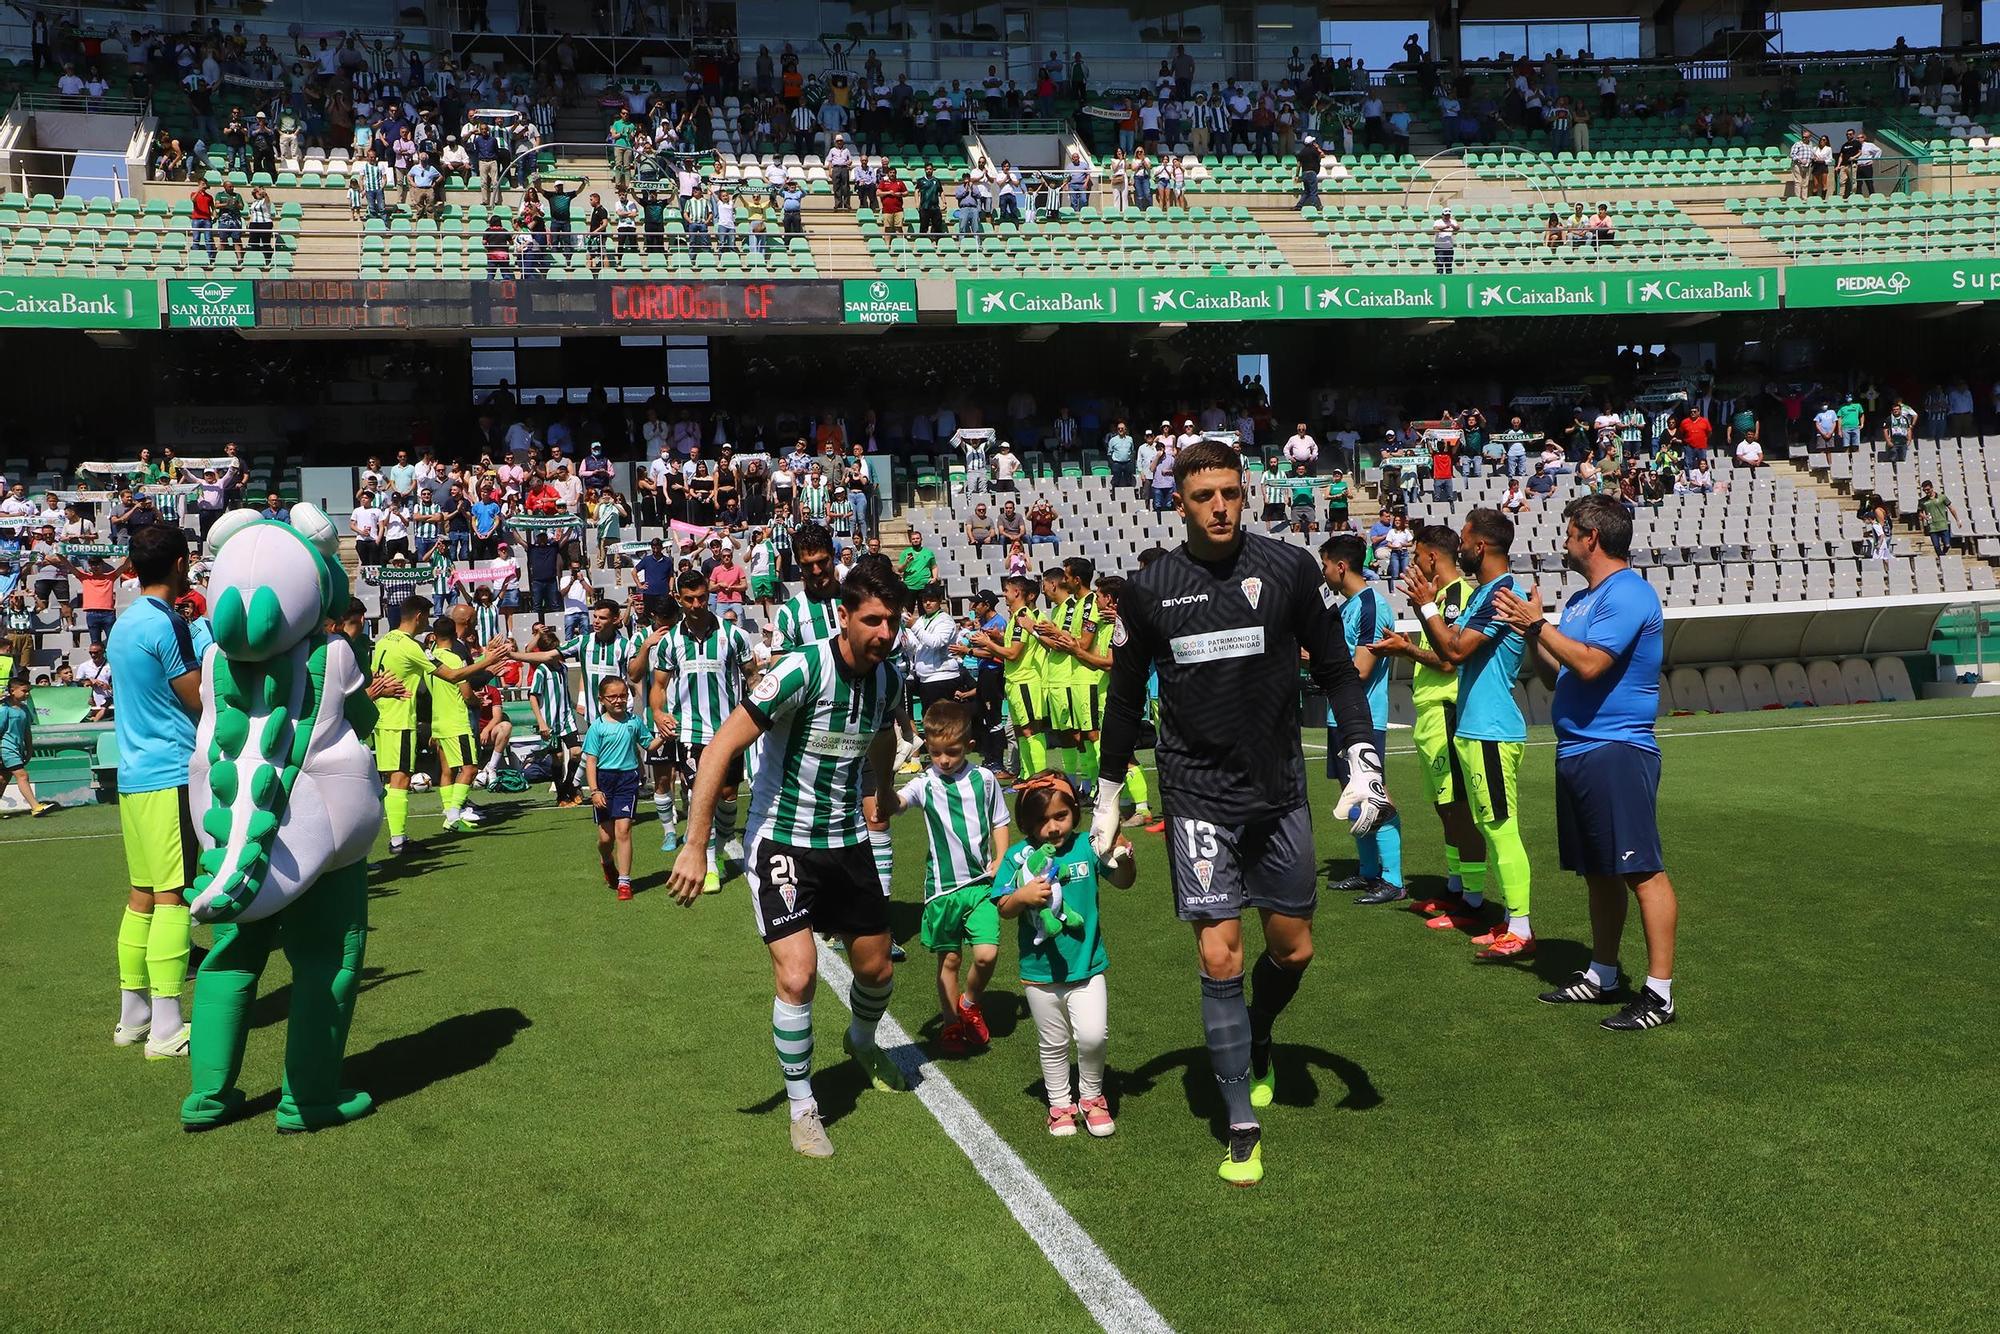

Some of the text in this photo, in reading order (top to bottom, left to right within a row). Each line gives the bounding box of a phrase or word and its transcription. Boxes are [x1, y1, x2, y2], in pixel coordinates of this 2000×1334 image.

[204, 288, 222, 296] MINI
[1344, 287, 1434, 307] CaixaBank
[1506, 285, 1595, 305] CaixaBank
[1665, 280, 1753, 300] CaixaBank
[744, 284, 777, 320] CF
[845, 302, 913, 311] SAN RAFAEL
[1009, 291, 1104, 311] CaixaBank
[1179, 290, 1271, 309] CaixaBank
[171, 304, 254, 315] SAN RAFAEL
[860, 313, 899, 322] MOTOR
[189, 316, 238, 326] MOTOR
[1162, 594, 1209, 608] GIVOVA
[1207, 635, 1250, 646] PATRIMONIO
[1208, 641, 1260, 654] LA HUMANIDAD
[1184, 819, 1218, 859] 13
[769, 854, 798, 885] 21
[1186, 893, 1229, 904] GIVOVA
[771, 908, 809, 927] GIVOVA
